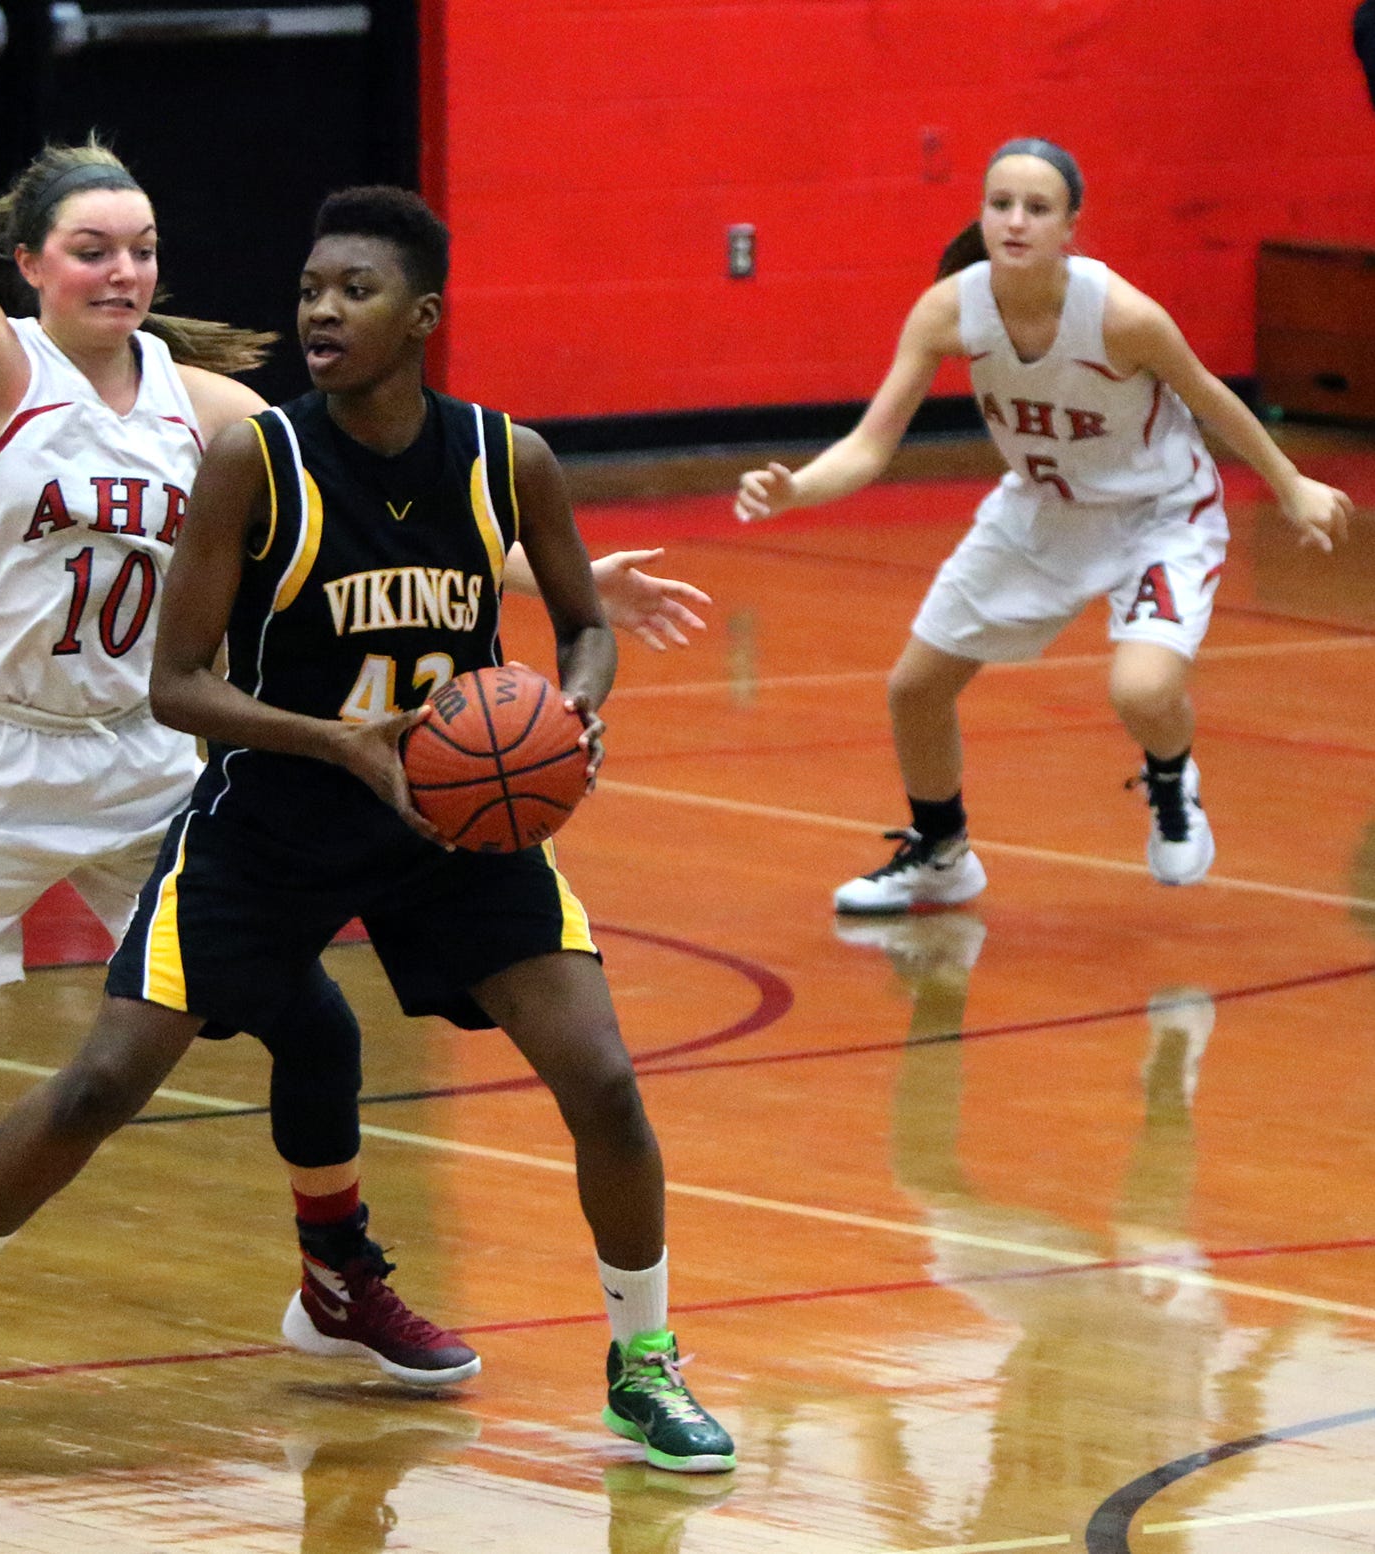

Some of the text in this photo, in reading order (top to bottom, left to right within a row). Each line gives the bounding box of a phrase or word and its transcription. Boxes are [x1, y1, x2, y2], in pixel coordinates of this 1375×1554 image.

[982, 392, 1112, 441] AHR
[51, 546, 157, 659] 10
[323, 565, 483, 637] VIKINGS
[1125, 562, 1182, 626] A
